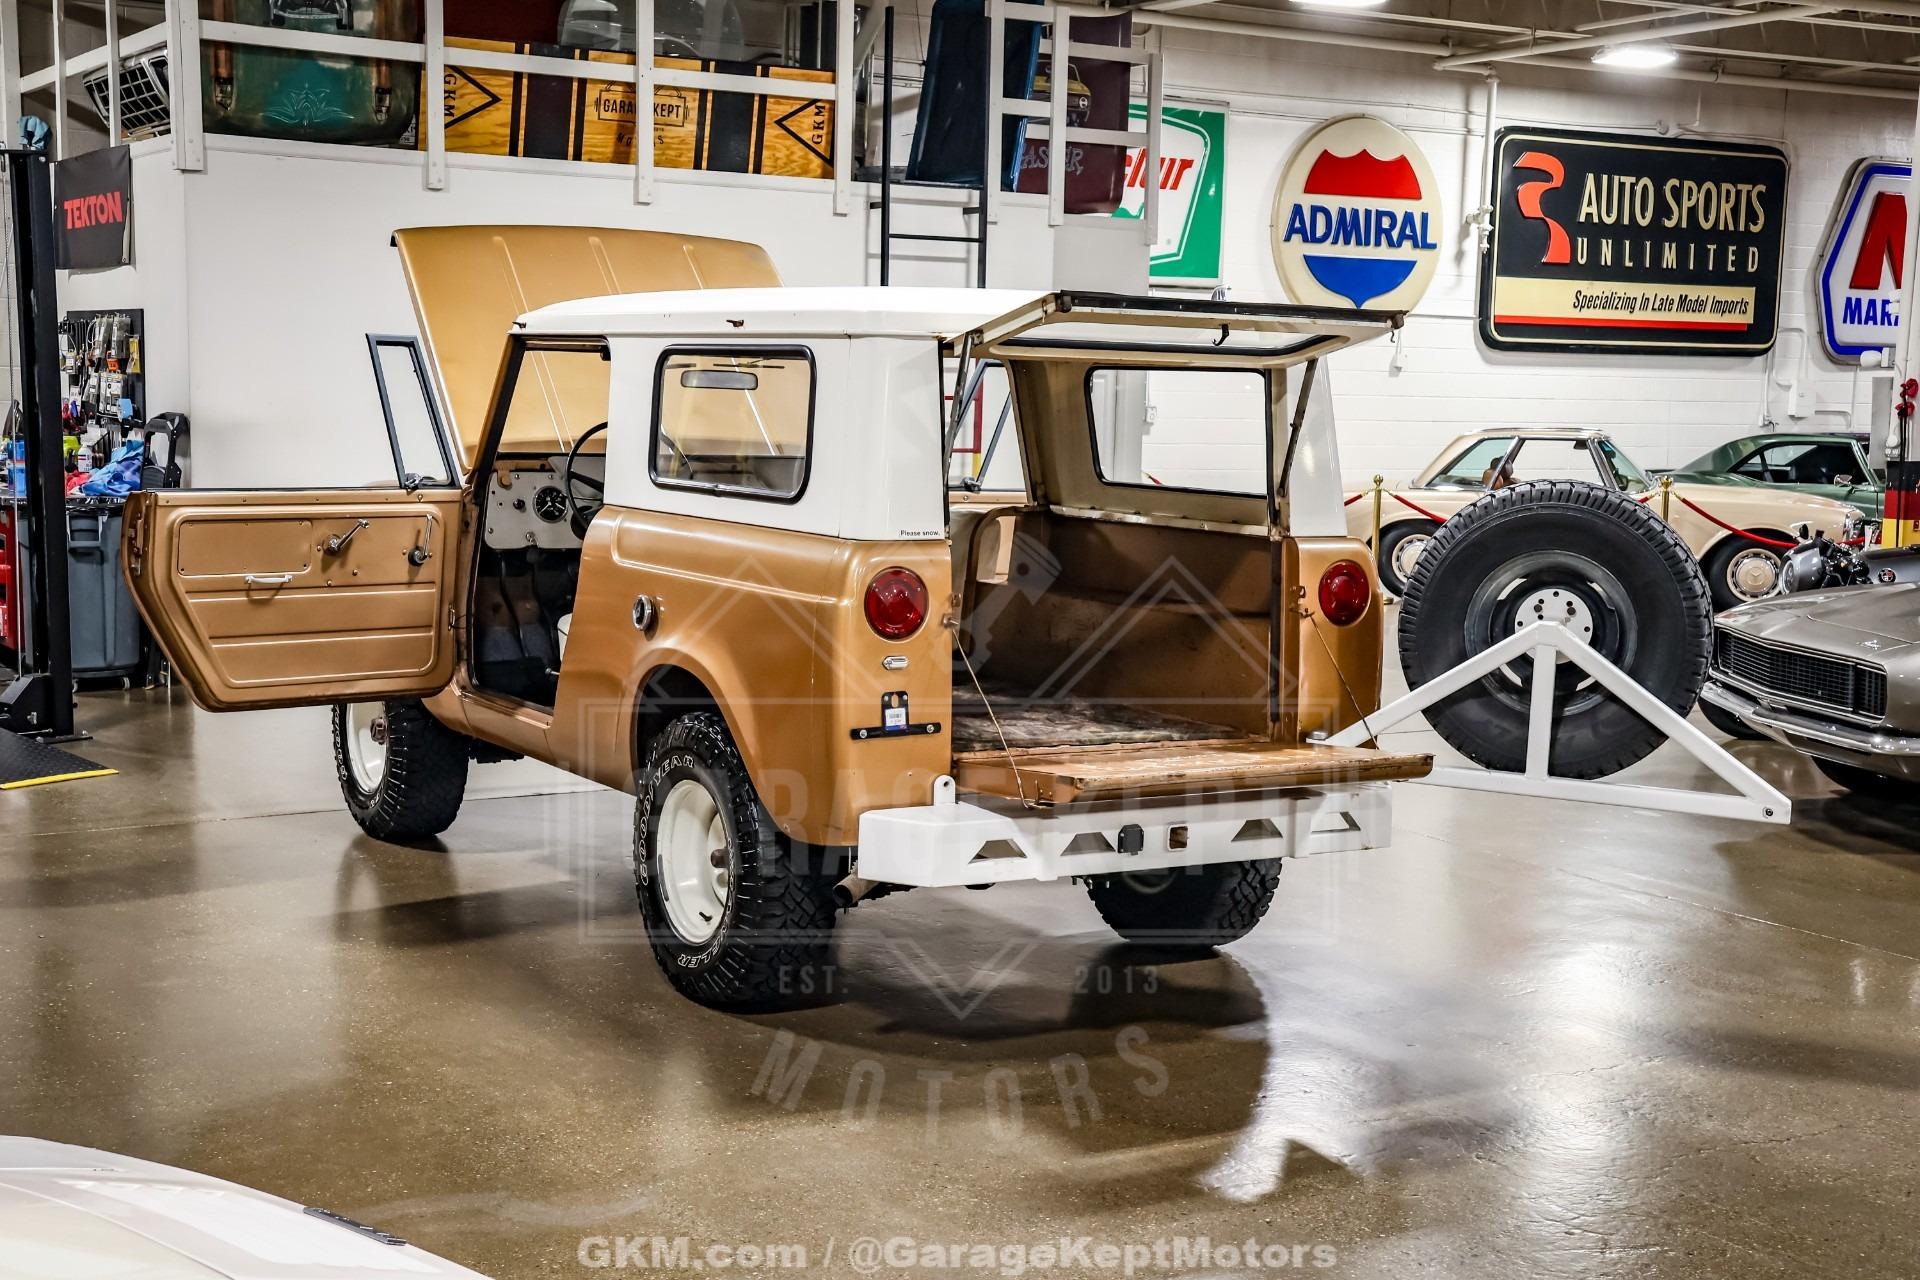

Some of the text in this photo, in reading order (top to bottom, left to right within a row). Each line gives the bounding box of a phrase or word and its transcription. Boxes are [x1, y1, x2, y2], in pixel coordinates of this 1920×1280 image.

[443, 73, 457, 118] GKM
[653, 102, 682, 119] KEPT
[811, 103, 826, 145] GKM
[63, 191, 123, 230] TEKTON
[1577, 172, 1767, 234] AUTO SPORTS
[1283, 203, 1438, 250] ADMIRAL
[1576, 237, 1760, 274] UNLIMITED
[1573, 290, 1750, 317] Specializing In Late Model Imports
[1842, 296, 1900, 327] MAR
[900, 529, 921, 537] Please
[639, 755, 695, 886] GOODYEAR
